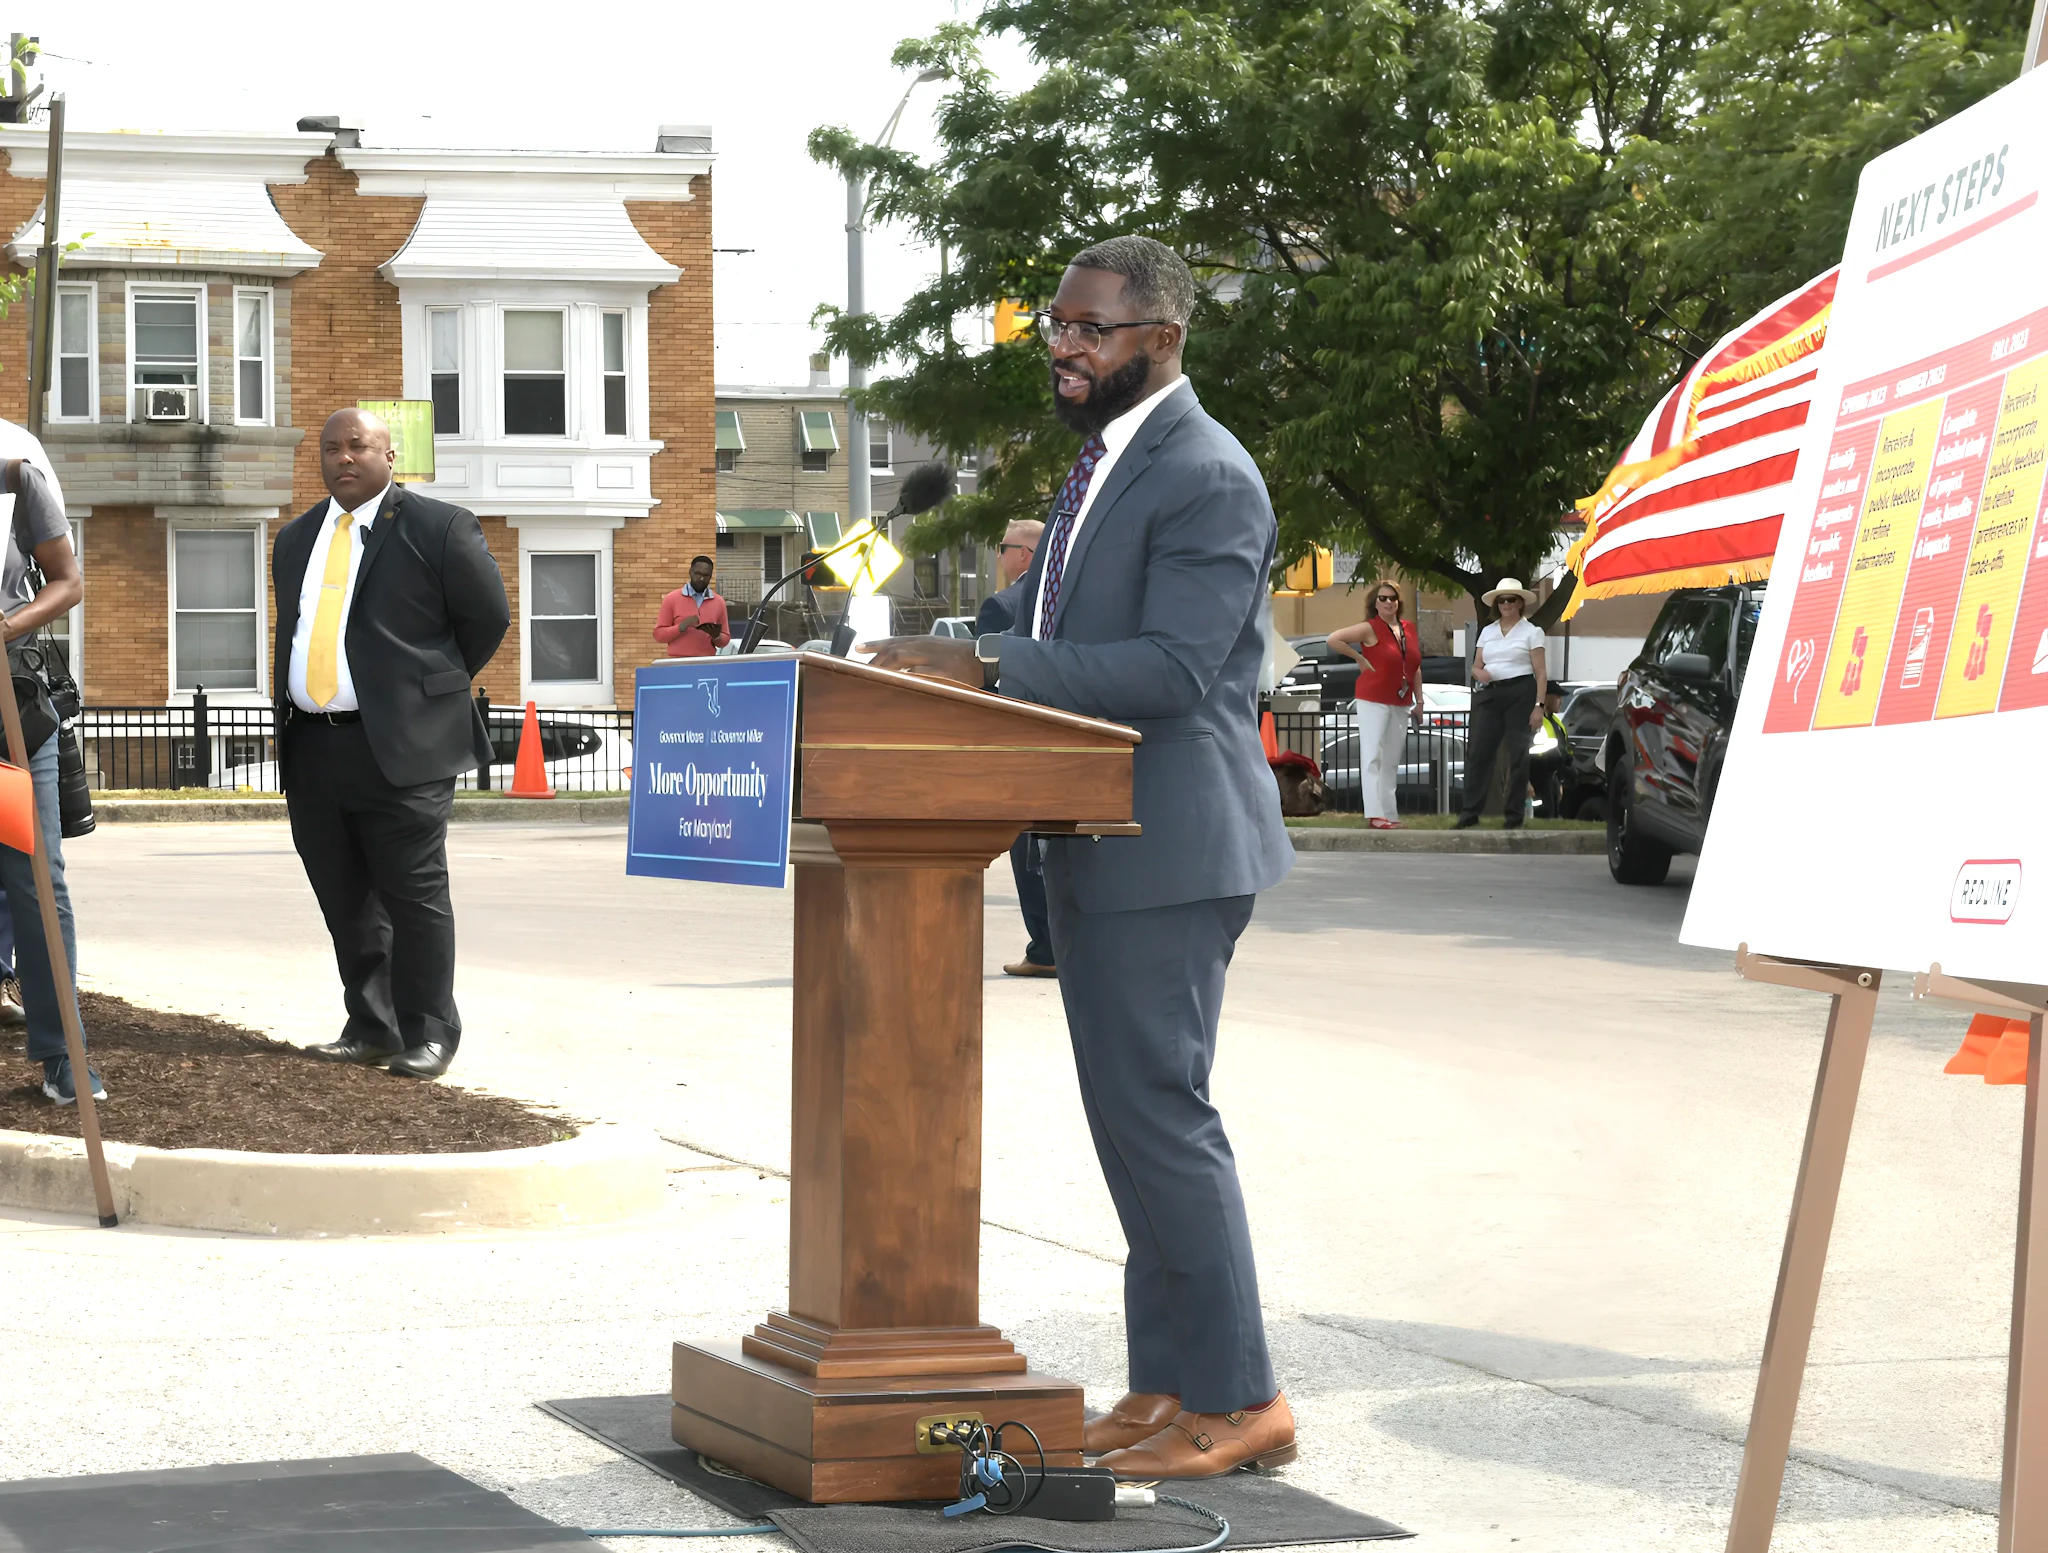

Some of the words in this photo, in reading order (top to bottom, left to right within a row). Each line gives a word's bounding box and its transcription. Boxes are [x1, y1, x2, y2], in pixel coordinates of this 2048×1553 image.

[1875, 183, 1936, 253] NEXT
[1936, 144, 2009, 225] STEPS
[648, 762, 683, 795] More
[685, 761, 768, 807] Opportunity
[679, 817, 693, 837] For
[693, 819, 732, 844] Maryland
